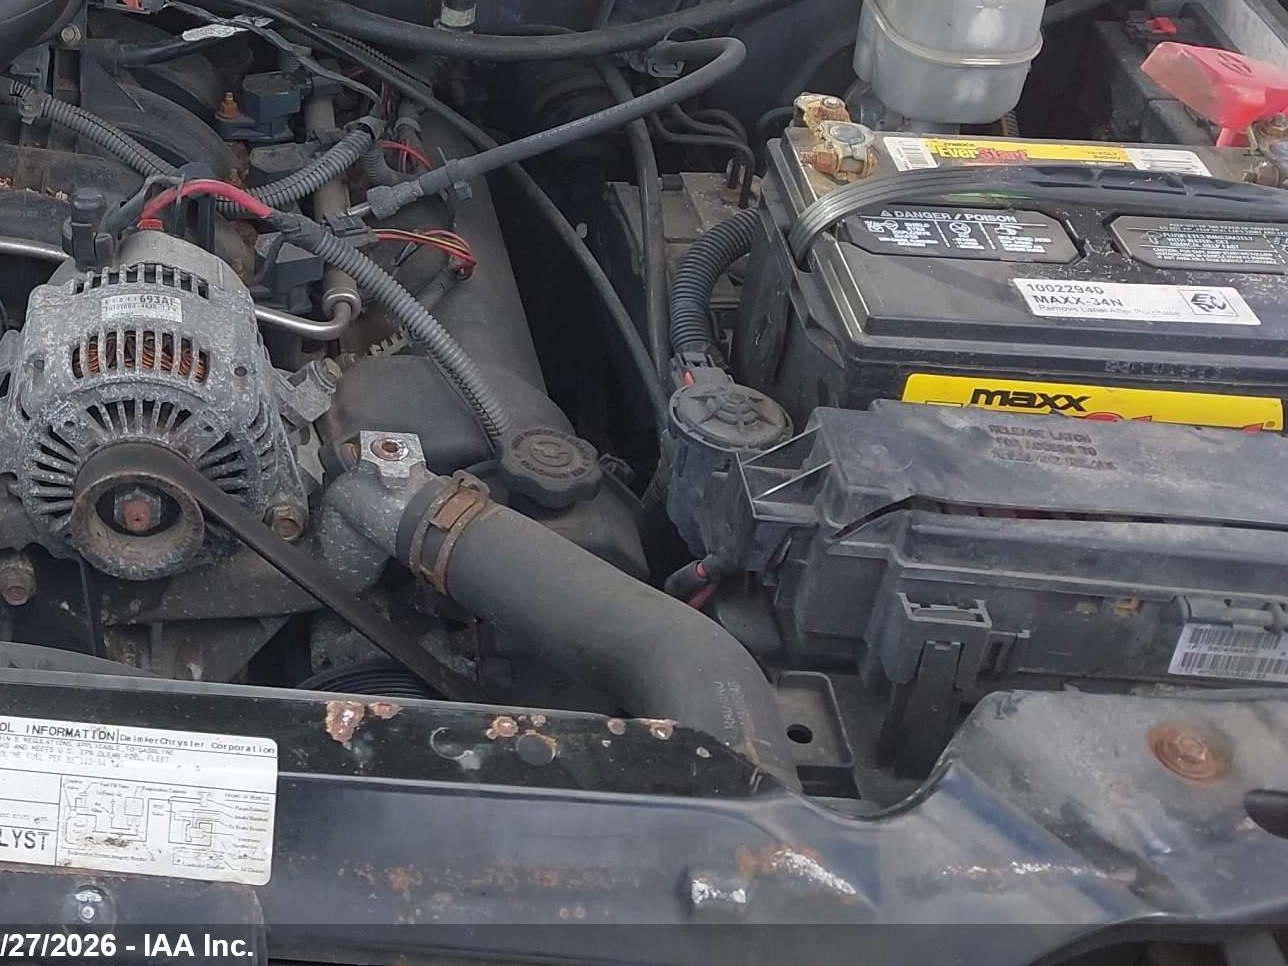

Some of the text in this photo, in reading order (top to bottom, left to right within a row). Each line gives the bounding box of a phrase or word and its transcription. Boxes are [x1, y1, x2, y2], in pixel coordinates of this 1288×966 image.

[936, 146, 1029, 161] EverStart
[894, 210, 952, 219] DANGER
[964, 214, 1017, 223] POISON
[1032, 295, 1124, 307] MAXX-34N
[970, 388, 1092, 412] maxx
[26, 725, 116, 741] INFORMATION
[211, 742, 275, 754] Corporation
